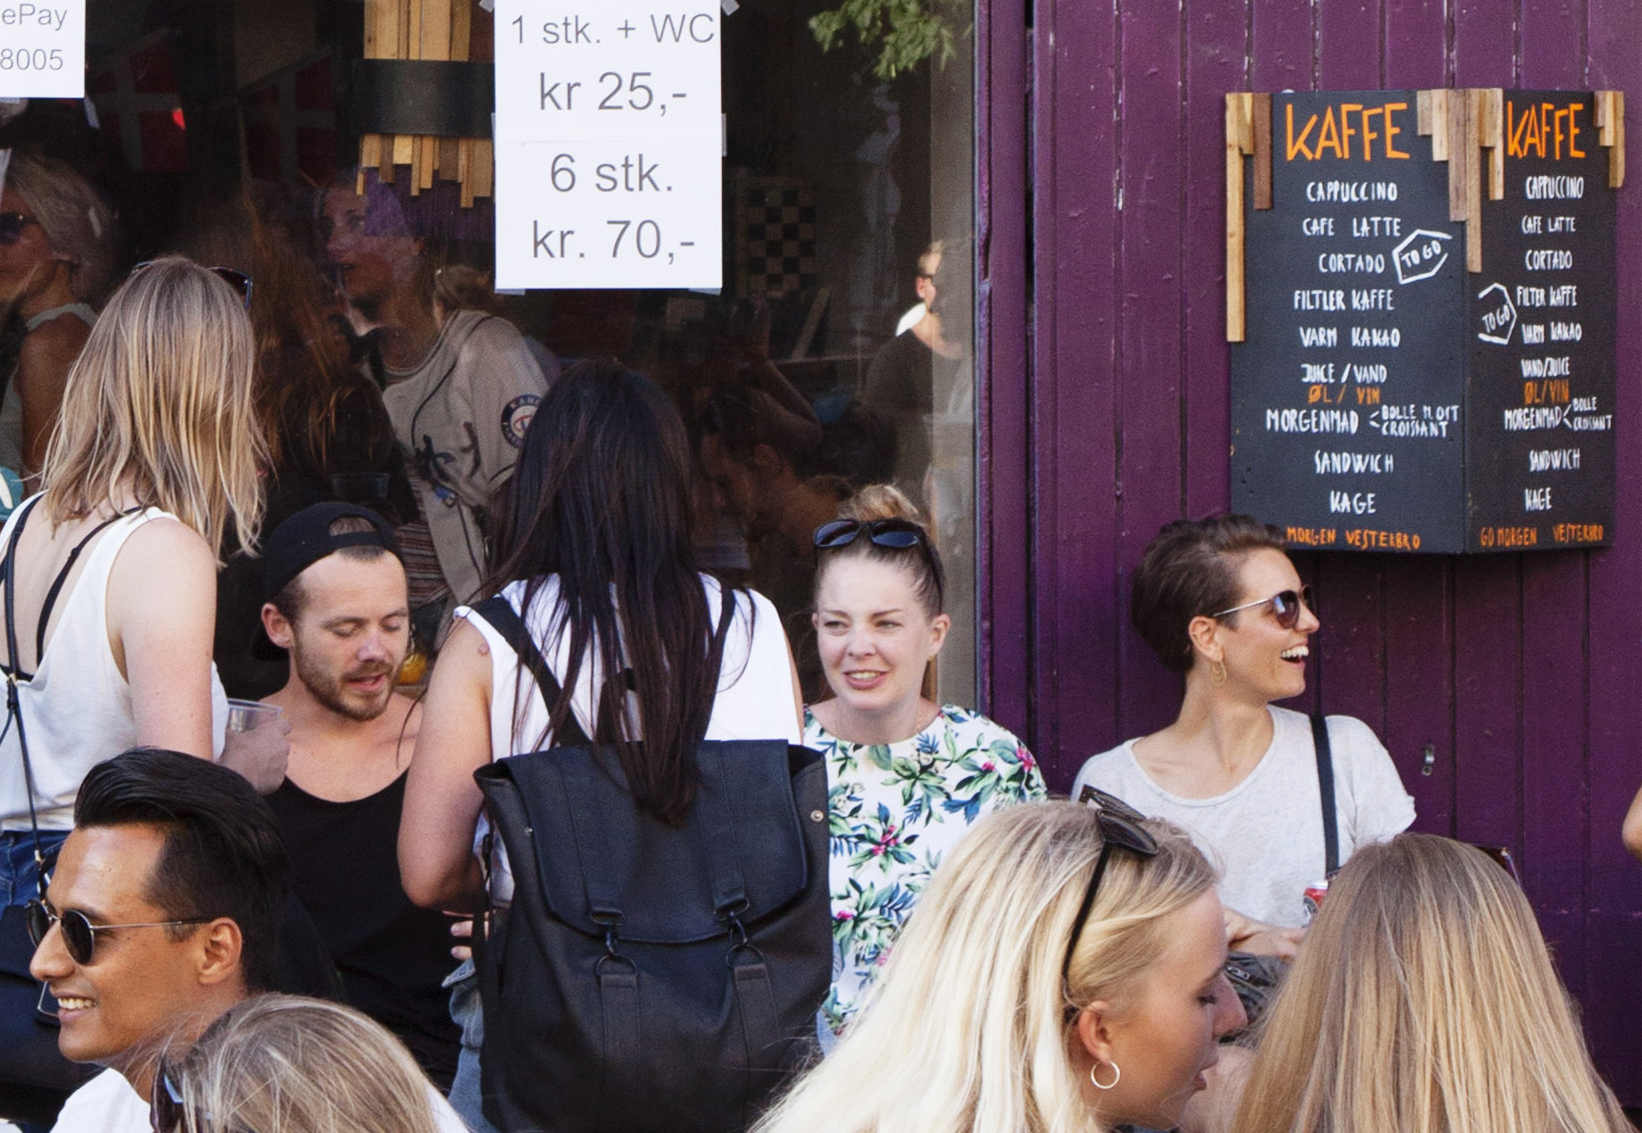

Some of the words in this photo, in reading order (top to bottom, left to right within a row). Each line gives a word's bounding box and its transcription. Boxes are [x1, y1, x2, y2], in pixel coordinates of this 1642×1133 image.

[512, 15, 524, 44] 1
[542, 15, 601, 44] stk.
[617, 20, 636, 38] +
[650, 13, 714, 43] WC
[540, 72, 581, 110] kr
[598, 72, 686, 117] 25,-
[1286, 103, 1410, 161] KAFFE
[1508, 101, 1586, 160] KAFFE
[550, 153, 576, 192] 6
[595, 153, 672, 192] stk.
[1306, 180, 1398, 202] CAPPUCCINO
[1526, 176, 1584, 199] CAPPUCCINO
[1302, 217, 1334, 236] CAFE
[1352, 217, 1401, 237] LATTE
[1521, 215, 1542, 233] CAFE
[1548, 216, 1576, 233] LATTE
[533, 220, 585, 258] kr.
[607, 220, 694, 265] 70,-
[1318, 253, 1385, 274] CORTADO
[1401, 250, 1420, 268] TO
[1422, 240, 1441, 260] GO
[1525, 250, 1572, 270] CORTADO
[1351, 289, 1395, 311] KAFFE
[1516, 285, 1546, 307] FILTER
[1549, 285, 1577, 307] KAFFE
[1482, 312, 1496, 333] TO
[1550, 321, 1582, 342] KAKAO
[1299, 326, 1337, 347] VARM
[1351, 326, 1401, 347] KAKAO
[1301, 363, 1335, 383] JUICE
[1266, 409, 1359, 434] MORGENMAD
[1381, 405, 1416, 420] BOLLE
[1504, 406, 1562, 431] MORGENMAD
[1381, 420, 1448, 438] CROISSANT
[1314, 450, 1394, 474] SANDWICH
[1529, 449, 1581, 472] SANDWICH
[1329, 490, 1377, 514] KAGE
[1525, 487, 1552, 511] KAGE
[1286, 527, 1337, 545] MORGEN
[1480, 527, 1495, 546] GO
[1497, 526, 1538, 546] MORGEN
